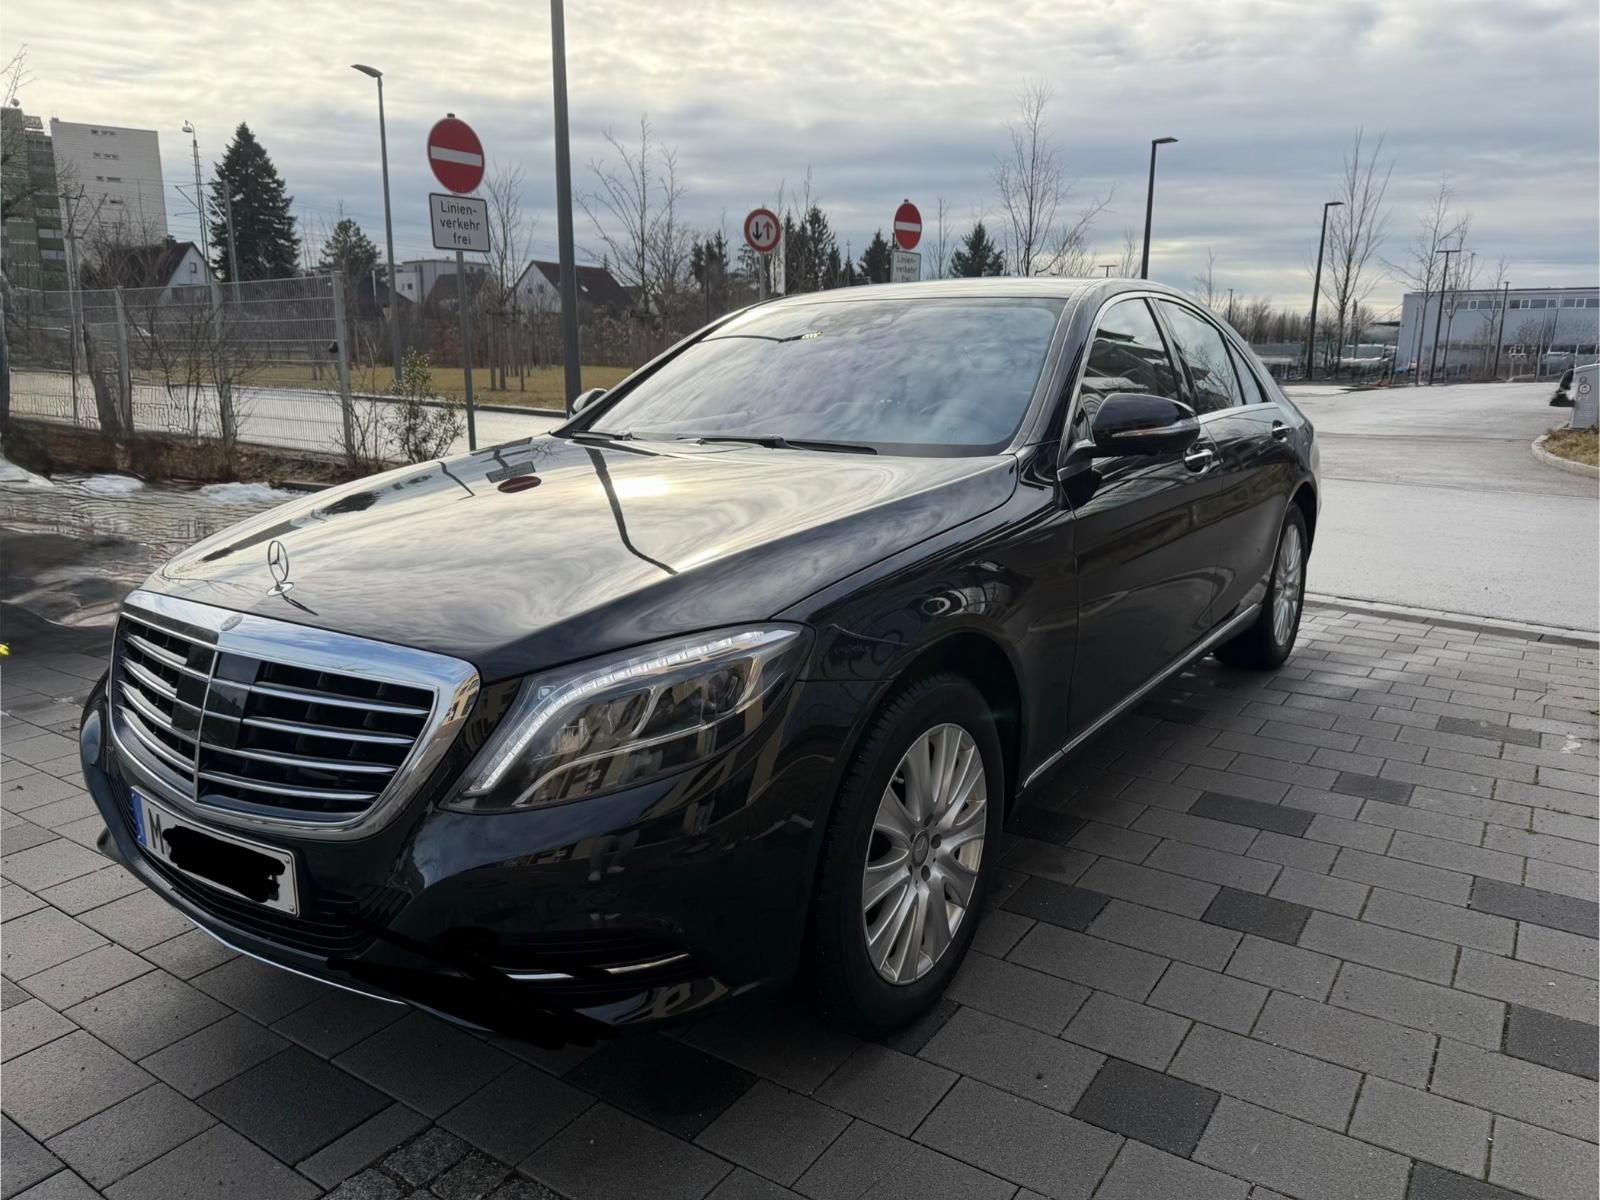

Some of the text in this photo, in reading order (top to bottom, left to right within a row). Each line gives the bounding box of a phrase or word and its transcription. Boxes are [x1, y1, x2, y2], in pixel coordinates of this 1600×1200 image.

[440, 200, 477, 215] Linien-
[440, 218, 480, 231] verkehr
[453, 231, 471, 245] frei
